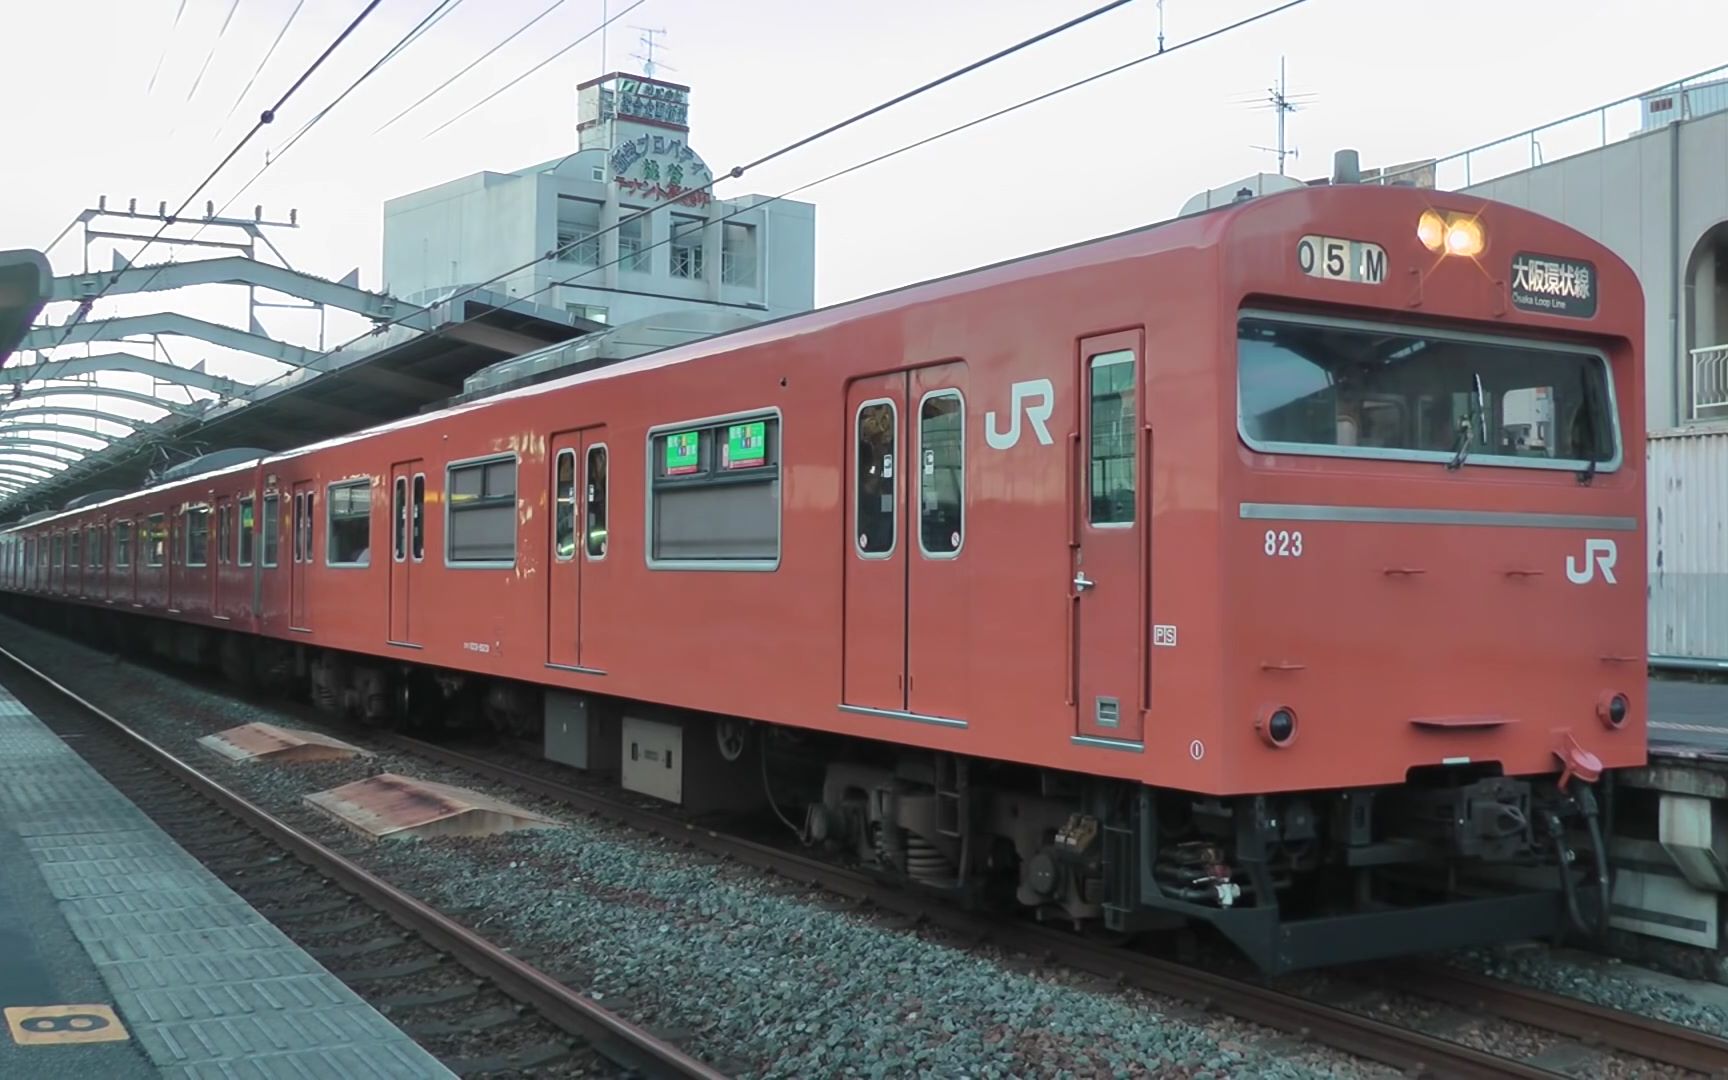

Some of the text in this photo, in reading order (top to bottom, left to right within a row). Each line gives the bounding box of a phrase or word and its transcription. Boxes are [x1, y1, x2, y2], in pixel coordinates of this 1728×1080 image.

[1512, 257, 1591, 300] 大阪環状線
[1512, 291, 1567, 308] Osaka Loop Line
[985, 378, 1055, 450] JR
[1264, 529, 1303, 557] 823
[1566, 538, 1618, 585] JR
[1155, 627, 1175, 644] PS
